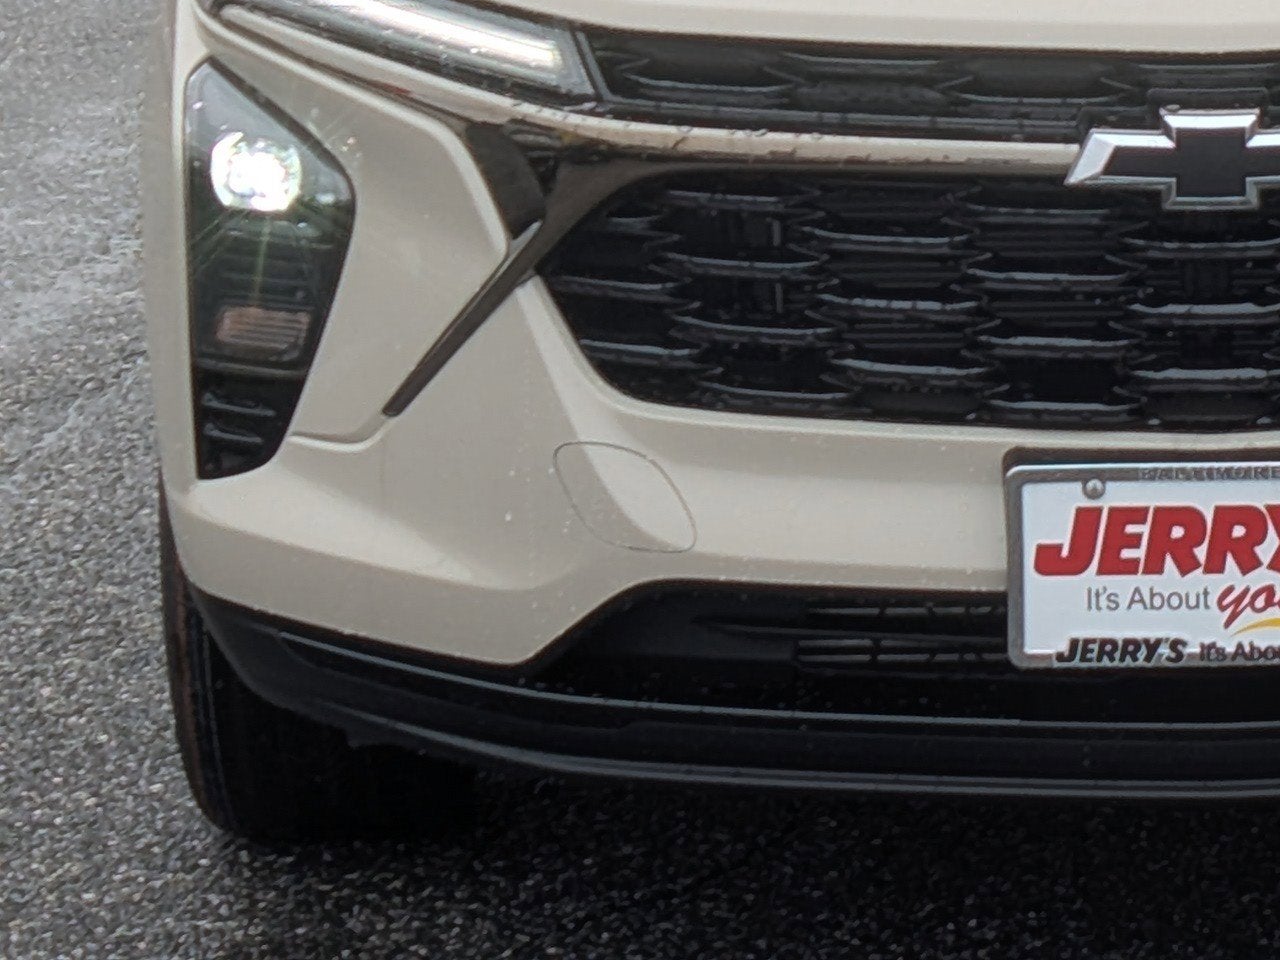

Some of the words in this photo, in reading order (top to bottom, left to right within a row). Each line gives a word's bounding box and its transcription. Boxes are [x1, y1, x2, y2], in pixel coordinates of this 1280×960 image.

[1086, 586, 1120, 611] It's
[1127, 586, 1210, 611] About
[1055, 637, 1188, 664] JERRY'S
[1199, 641, 1226, 661] It's
